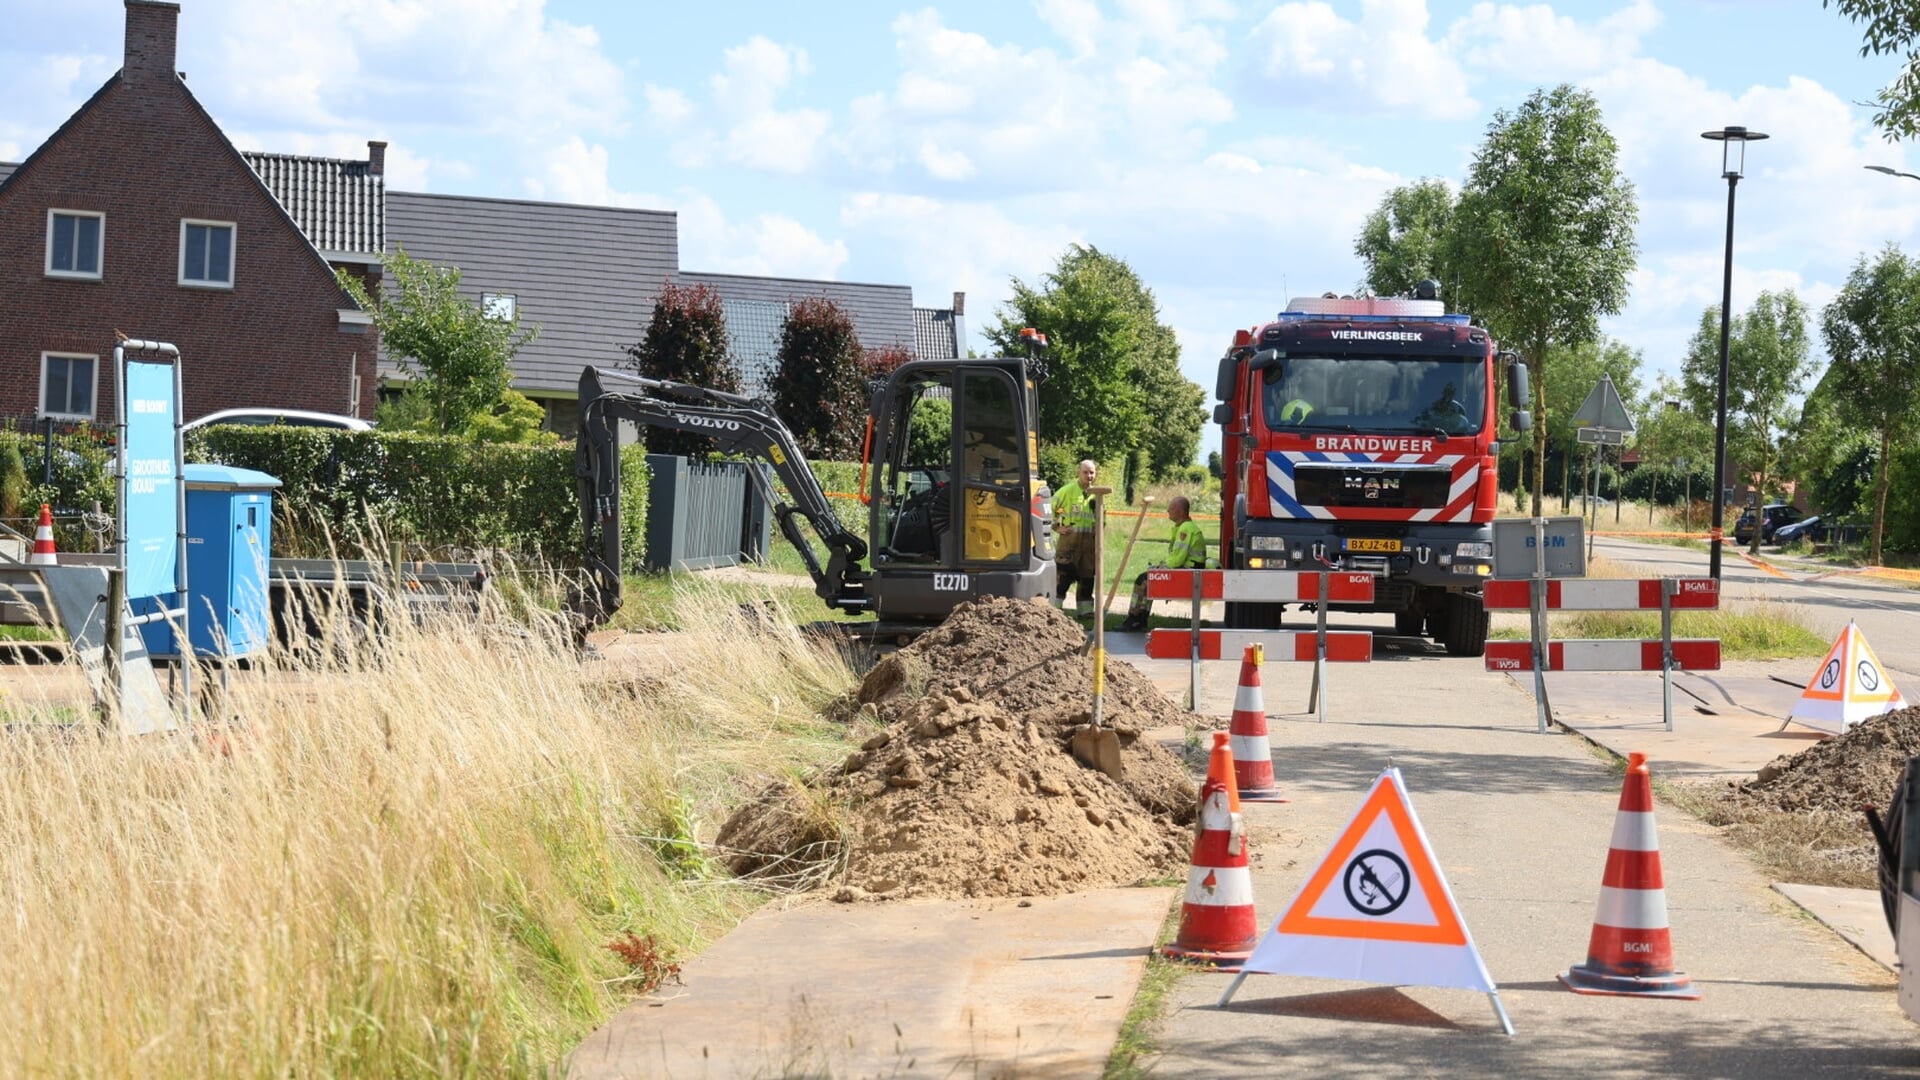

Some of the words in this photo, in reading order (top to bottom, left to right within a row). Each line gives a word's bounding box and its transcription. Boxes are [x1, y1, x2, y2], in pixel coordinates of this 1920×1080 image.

[1331, 330, 1422, 341] VIERLINGSBEEK
[675, 413, 740, 431] VOLVO
[1316, 437, 1433, 452] BRANDWEER
[1345, 477, 1399, 489] MAN
[934, 574, 969, 591] EC27D
